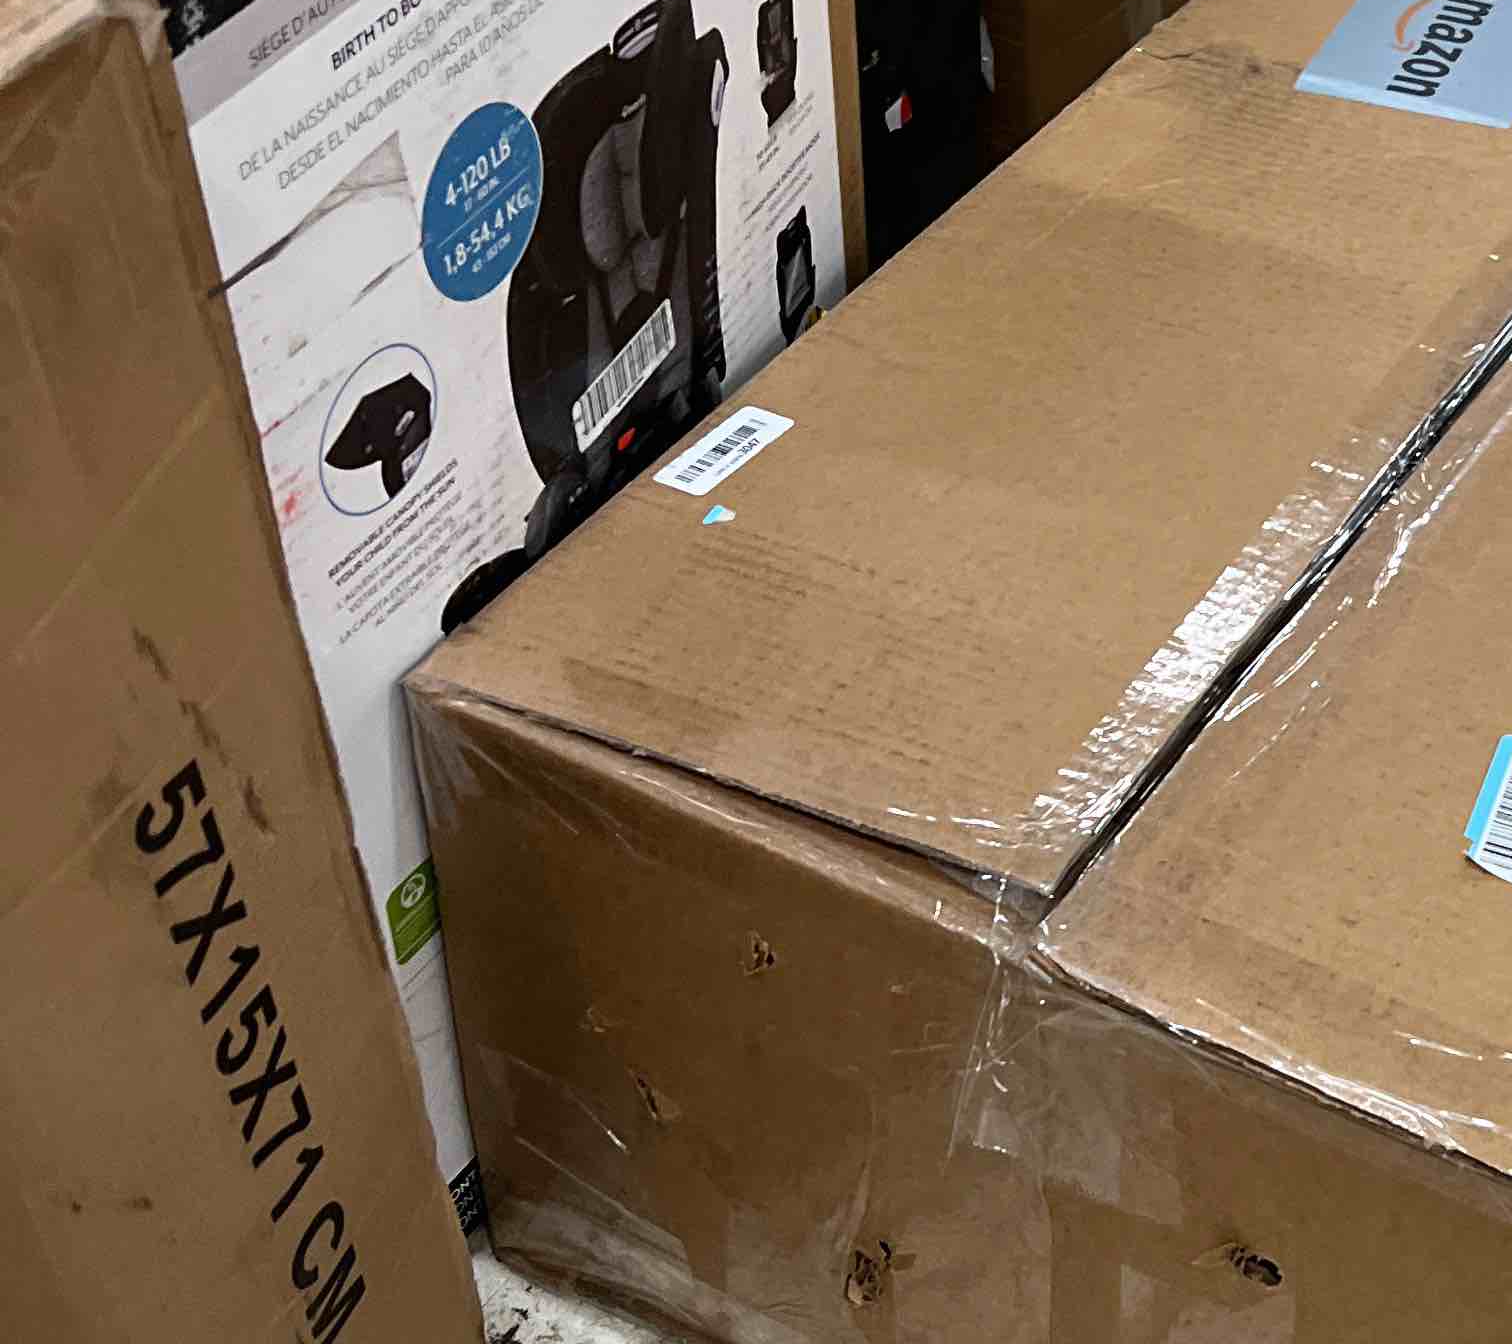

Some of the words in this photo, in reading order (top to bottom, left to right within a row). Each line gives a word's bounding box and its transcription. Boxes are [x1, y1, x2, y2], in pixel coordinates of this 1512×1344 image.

[331, 22, 375, 71] BIRTH
[377, 3, 398, 35] TO
[238, 152, 258, 183] DE
[260, 133, 281, 165] LA
[364, 51, 386, 84] AU
[277, 138, 326, 192] DESDE
[327, 123, 345, 153] EL
[444, 154, 489, 207] 4-120
[489, 139, 511, 168] LB
[507, 183, 530, 221] KG
[135, 758, 323, 1223] 57X15X71
